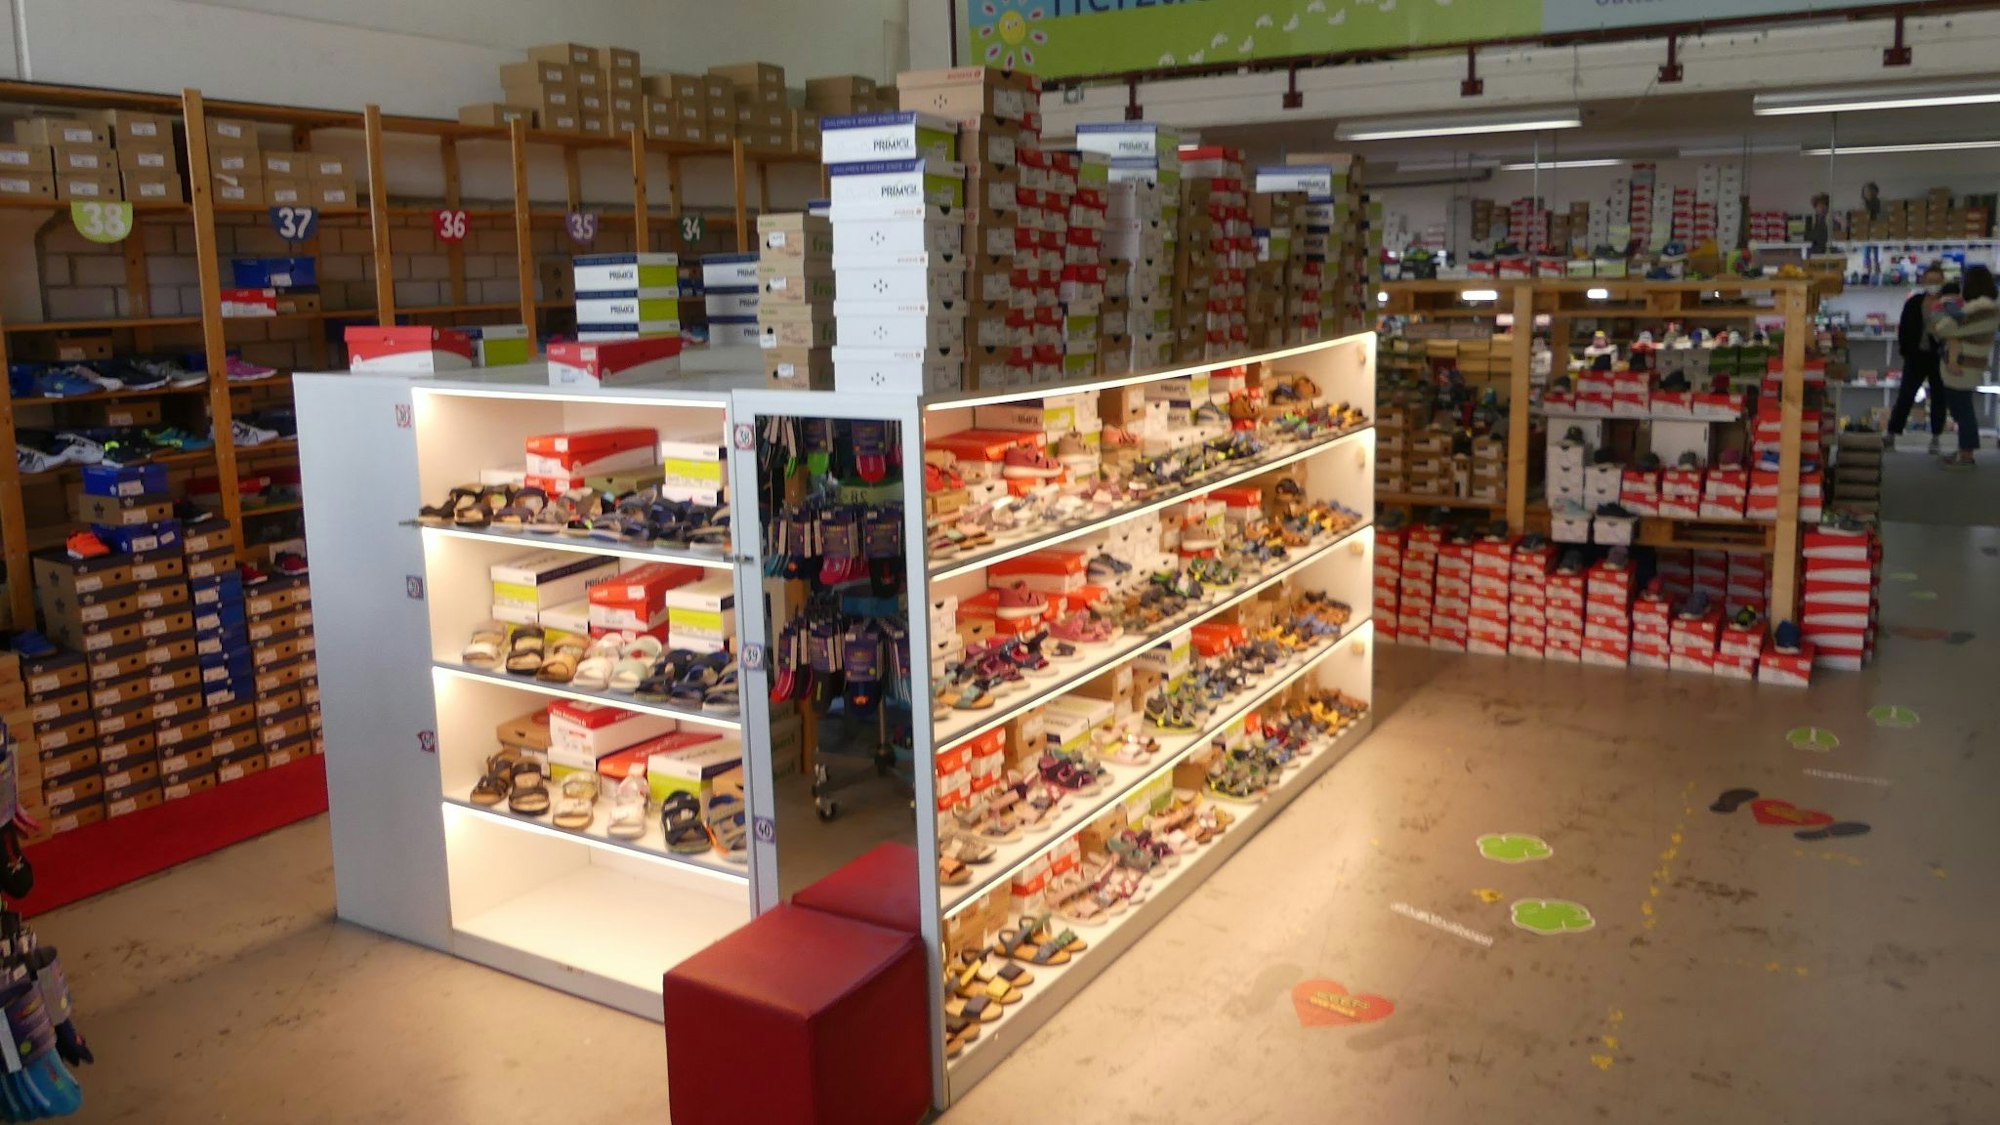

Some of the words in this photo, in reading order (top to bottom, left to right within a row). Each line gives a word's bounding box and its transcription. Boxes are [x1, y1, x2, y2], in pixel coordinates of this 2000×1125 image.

[82, 202, 126, 236] 38
[278, 206, 313, 240] 37
[440, 210, 466, 238] 36
[571, 214, 594, 240] 35
[682, 216, 701, 241] 34
